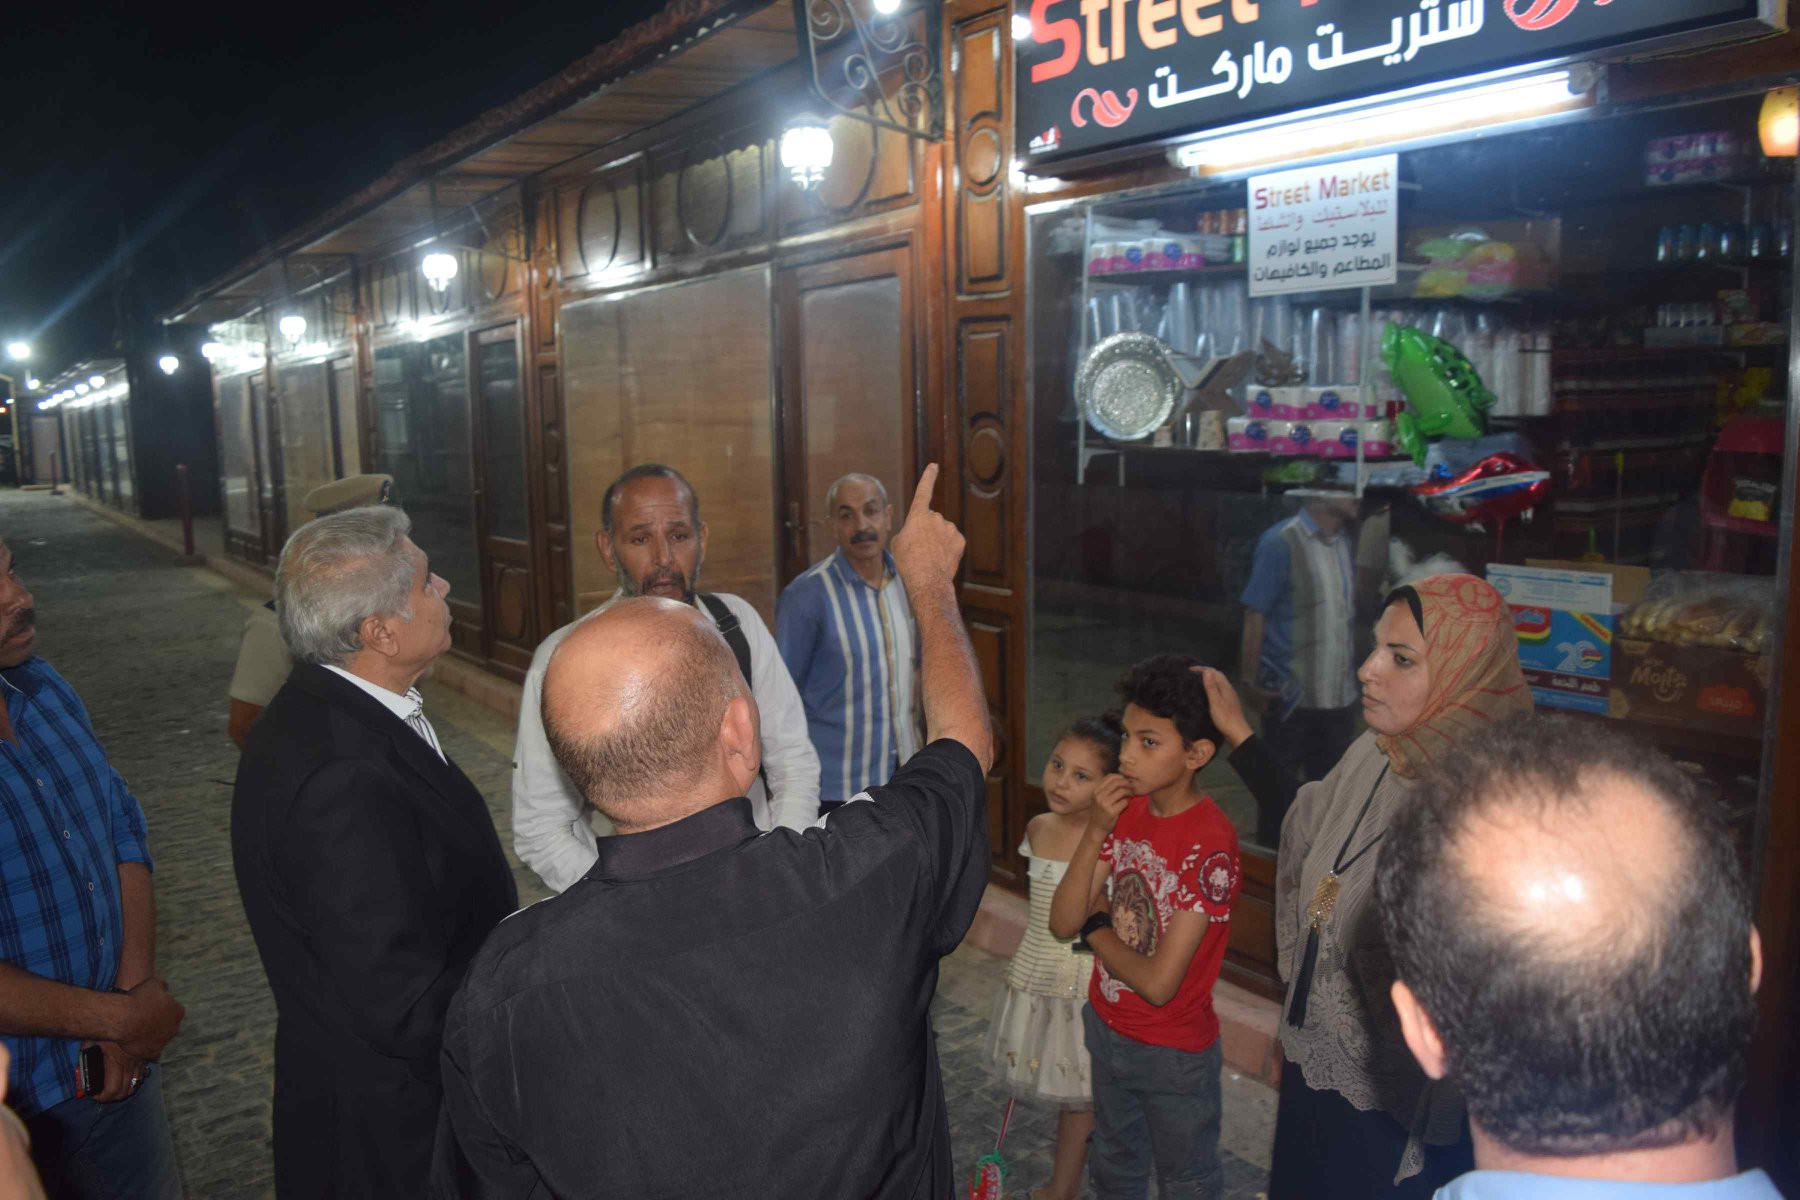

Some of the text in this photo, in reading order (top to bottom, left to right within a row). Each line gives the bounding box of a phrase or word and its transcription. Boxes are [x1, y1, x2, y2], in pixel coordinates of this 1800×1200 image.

[1149, 0, 1484, 109] ستريت ماركت
[1254, 168, 1390, 210] Street Market
[1265, 231, 1376, 260] يوجد جميع لوازم
[1253, 252, 1391, 283] المطاعم والكافيهات
